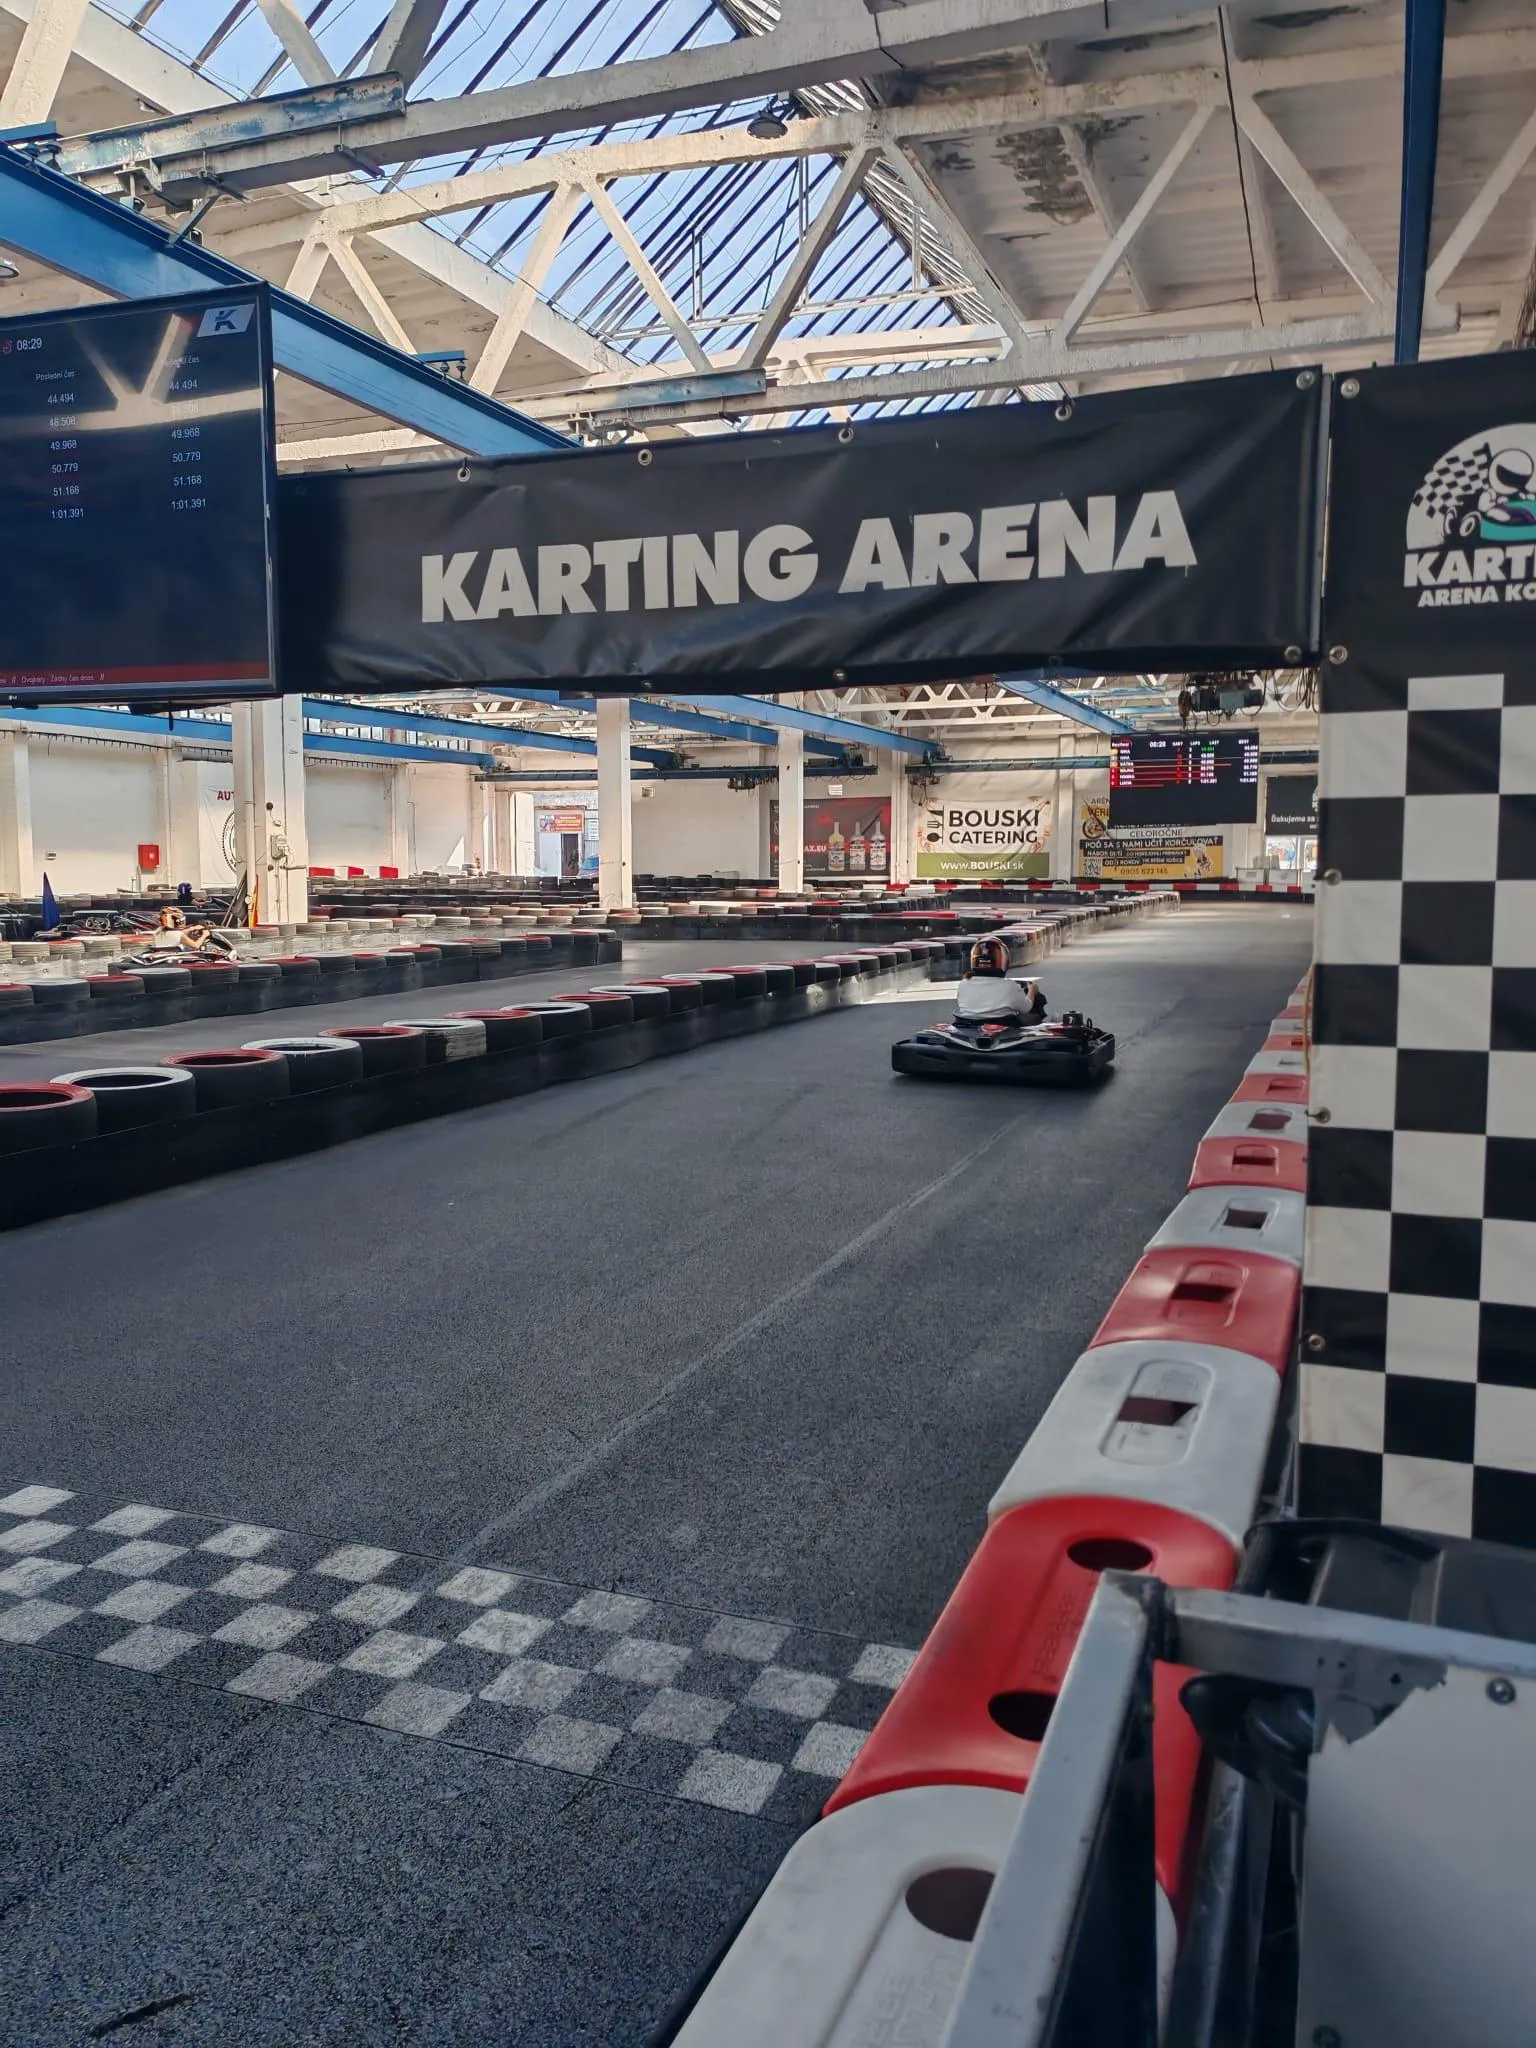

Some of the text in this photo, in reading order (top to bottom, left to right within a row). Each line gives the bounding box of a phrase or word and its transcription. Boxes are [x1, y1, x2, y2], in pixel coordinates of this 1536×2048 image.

[17, 338, 42, 351] 08:29
[168, 380, 198, 391] 44.494
[47, 393, 74, 404] 44.494
[49, 416, 76, 427] 48.508
[171, 428, 200, 438] 49.968
[50, 439, 77, 451] 49.968
[172, 451, 201, 463] 50.779
[51, 462, 79, 473] 50.779
[173, 475, 202, 486] 51.168
[53, 485, 80, 496] 51.168
[171, 498, 207, 511] 1:01.391
[51, 508, 84, 520] 1:01.391
[422, 490, 1198, 622] KARTING ARENA
[1403, 543, 1536, 588] KART
[1417, 584, 1500, 607] ARENA
[949, 810, 1040, 828] BOUSKI
[949, 830, 1038, 844] CATERING
[1085, 841, 1102, 849] POĎ
[1122, 839, 1143, 848] NAMI
[1144, 838, 1162, 848] UČIŤ
[940, 861, 1024, 871] www.BOUSKI.sk
